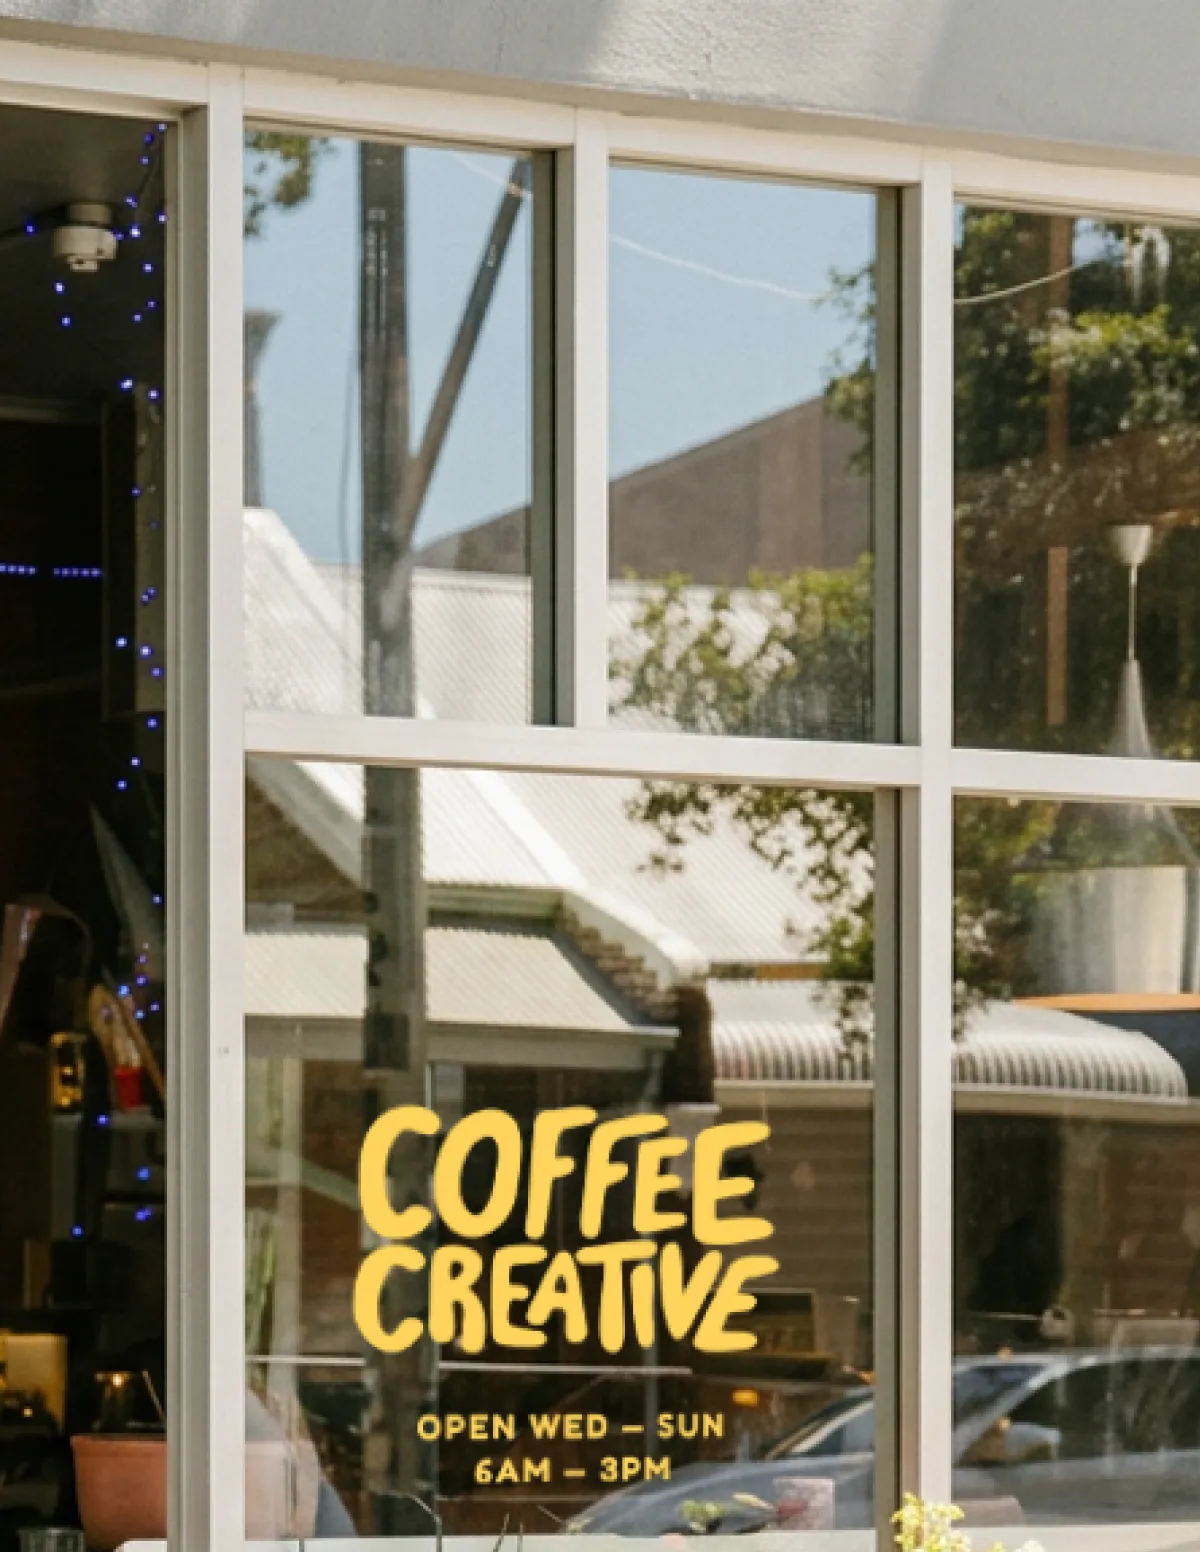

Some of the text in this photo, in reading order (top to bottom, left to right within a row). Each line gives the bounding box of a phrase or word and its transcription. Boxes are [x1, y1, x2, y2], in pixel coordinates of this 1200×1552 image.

[357, 1104, 775, 1246] COFFEE
[352, 1238, 780, 1354] CREATIVE
[416, 1413, 515, 1441] OPEN
[530, 1413, 607, 1440] WED
[657, 1413, 724, 1439] SUN
[475, 1457, 551, 1484] 6AM
[600, 1456, 671, 1482] 3PM
